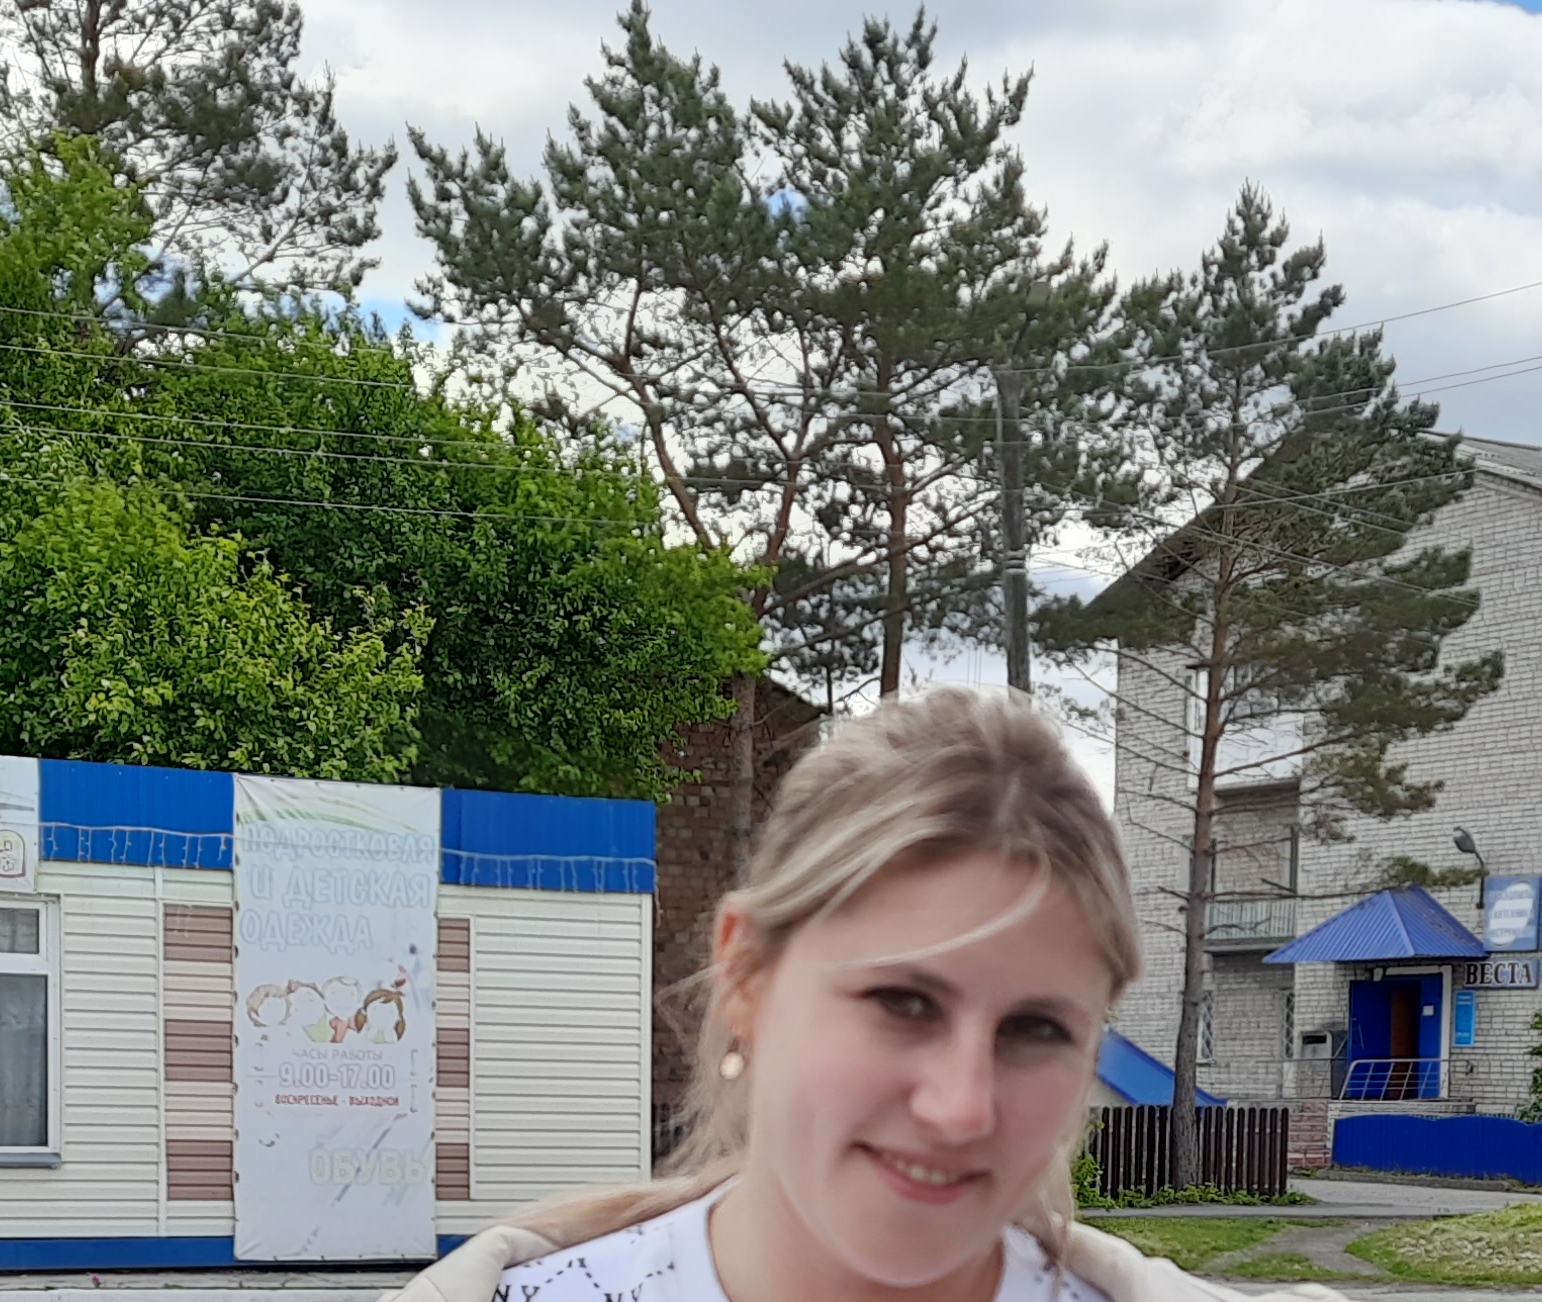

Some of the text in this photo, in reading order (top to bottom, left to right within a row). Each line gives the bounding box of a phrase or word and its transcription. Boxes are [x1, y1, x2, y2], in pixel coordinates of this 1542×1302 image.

[242, 823, 435, 864] ПОДРОСТКОВАЯ
[282, 866, 431, 910] ДЕТСКАЯ
[240, 908, 373, 954] ОДЕЖДА
[1465, 962, 1532, 985] ВЕСТА
[279, 1061, 396, 1090] 9.00-17.00
[311, 1150, 427, 1185] ОБУВЬ
